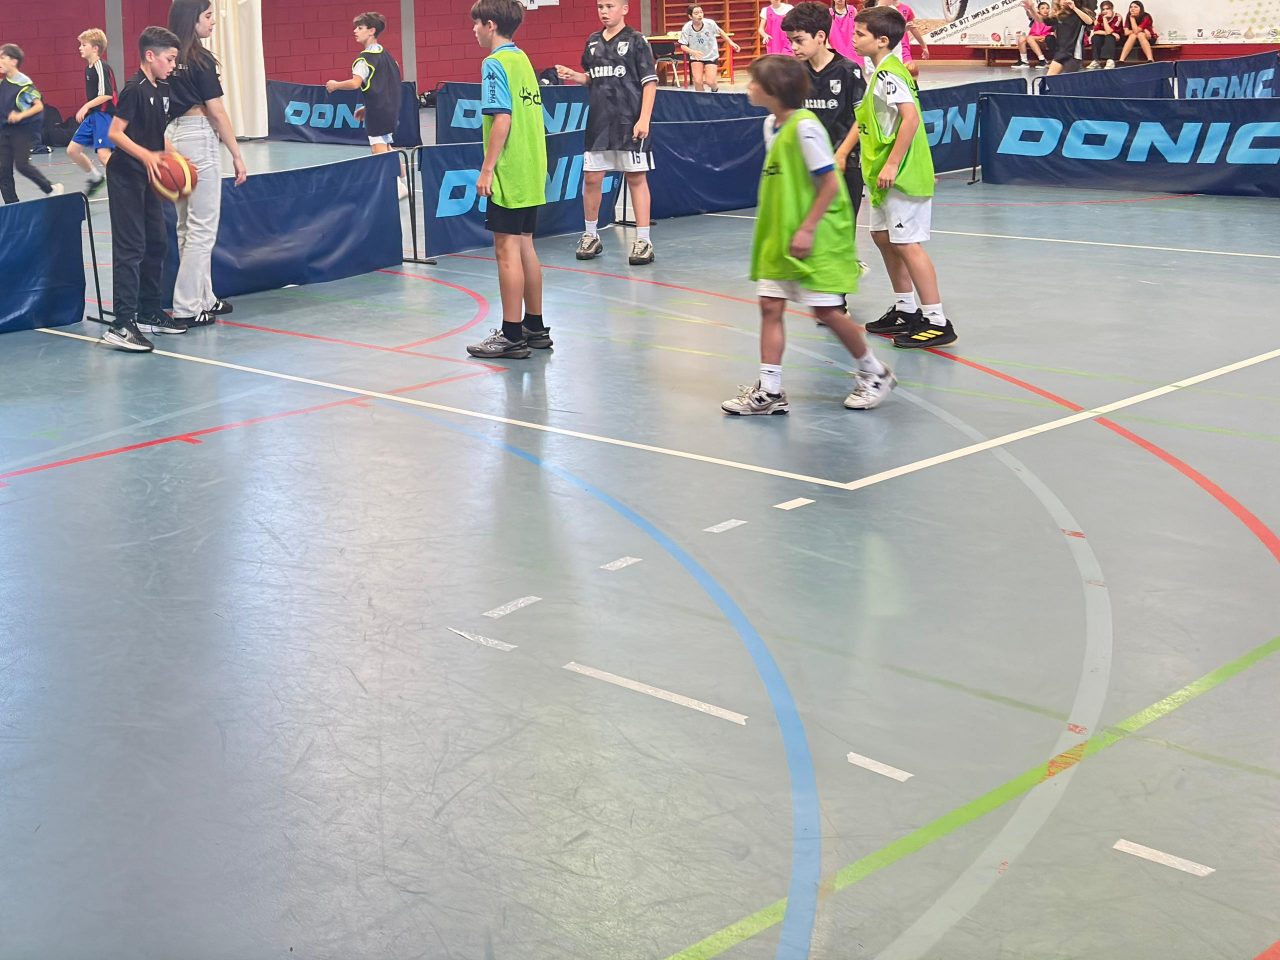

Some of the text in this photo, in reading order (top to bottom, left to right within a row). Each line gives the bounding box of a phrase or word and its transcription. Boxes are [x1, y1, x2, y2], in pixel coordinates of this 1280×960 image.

[958, 16, 970, 25] BTT
[285, 100, 366, 129] DON
[996, 116, 1280, 165] DONIC
